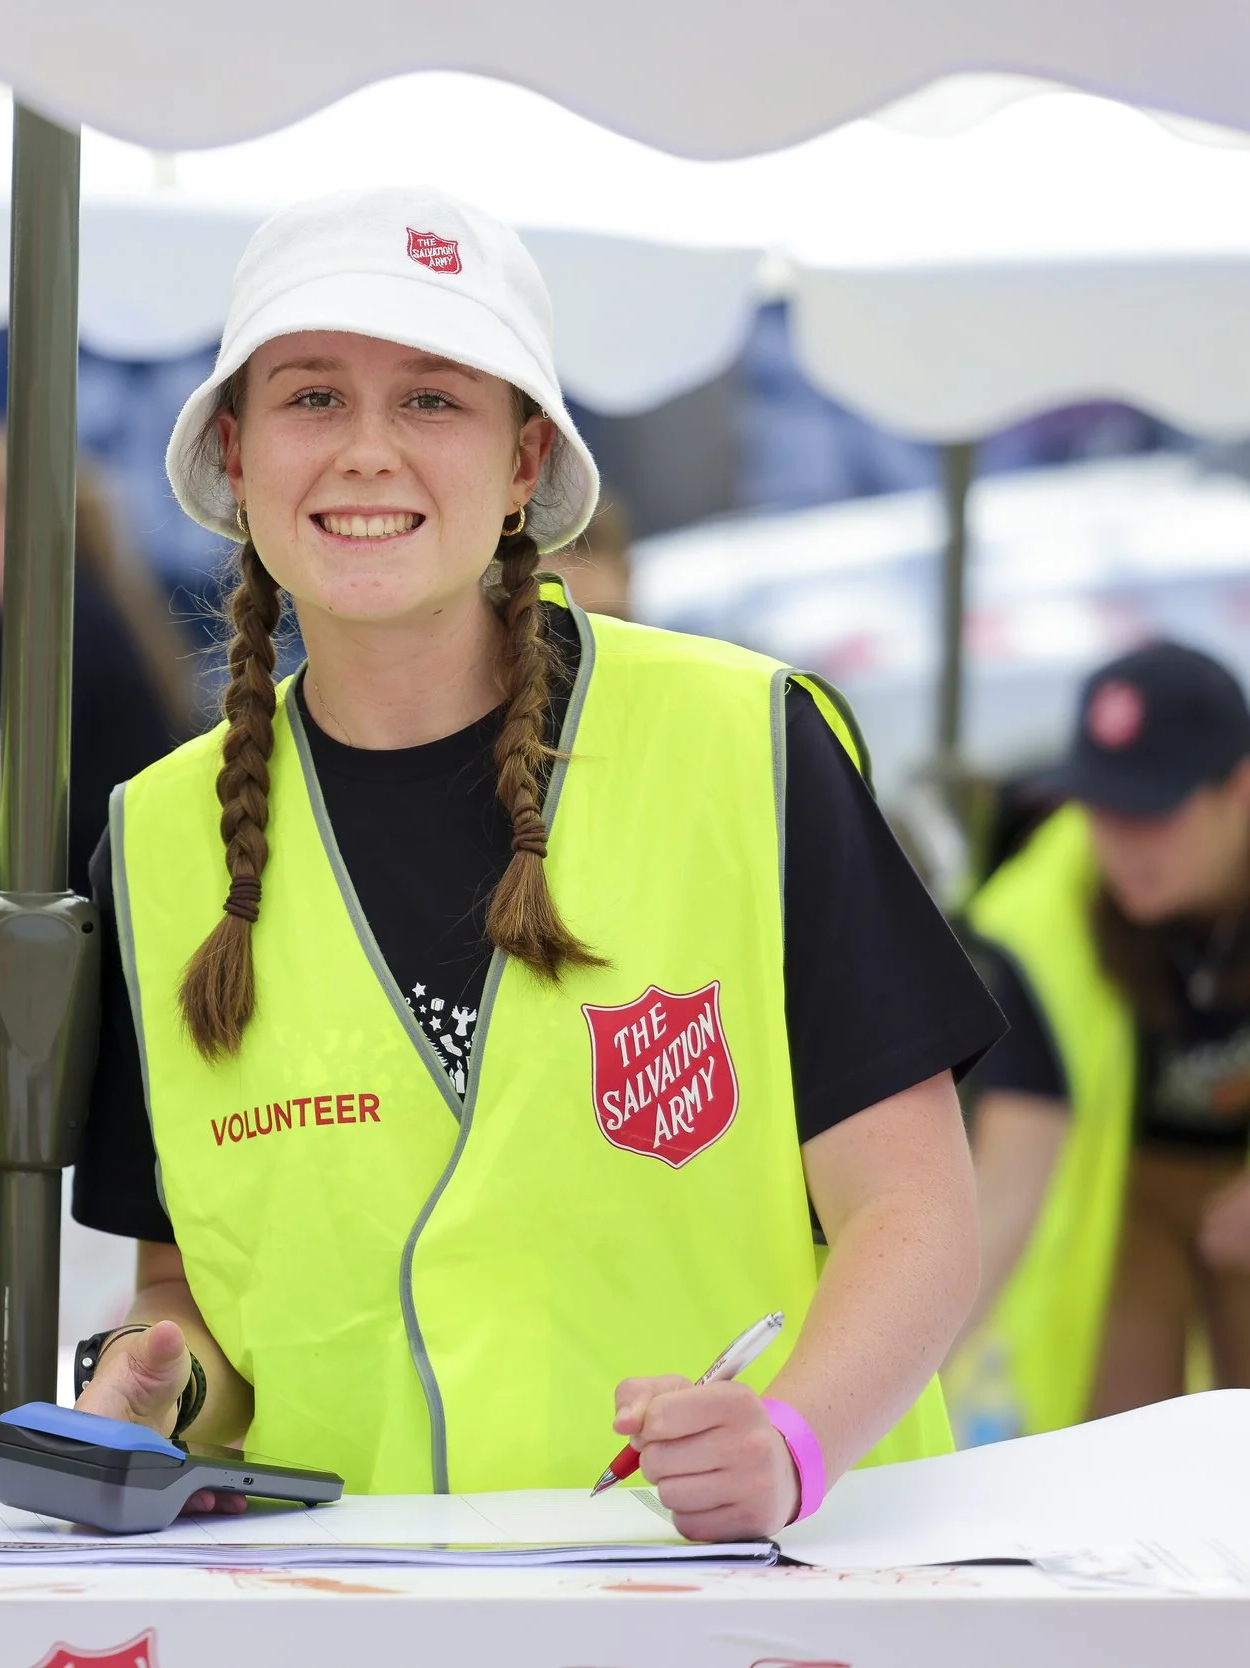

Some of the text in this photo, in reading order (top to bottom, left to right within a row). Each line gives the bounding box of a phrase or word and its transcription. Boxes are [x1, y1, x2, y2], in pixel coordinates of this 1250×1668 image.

[412, 245, 454, 258] SALVATION
[417, 238, 437, 247] THE
[429, 256, 453, 268] ARMY
[614, 1002, 667, 1068] THE
[602, 1002, 715, 1131] SALVATION
[210, 1093, 381, 1147] VOLUNTEER
[653, 1056, 715, 1149] ARMY
